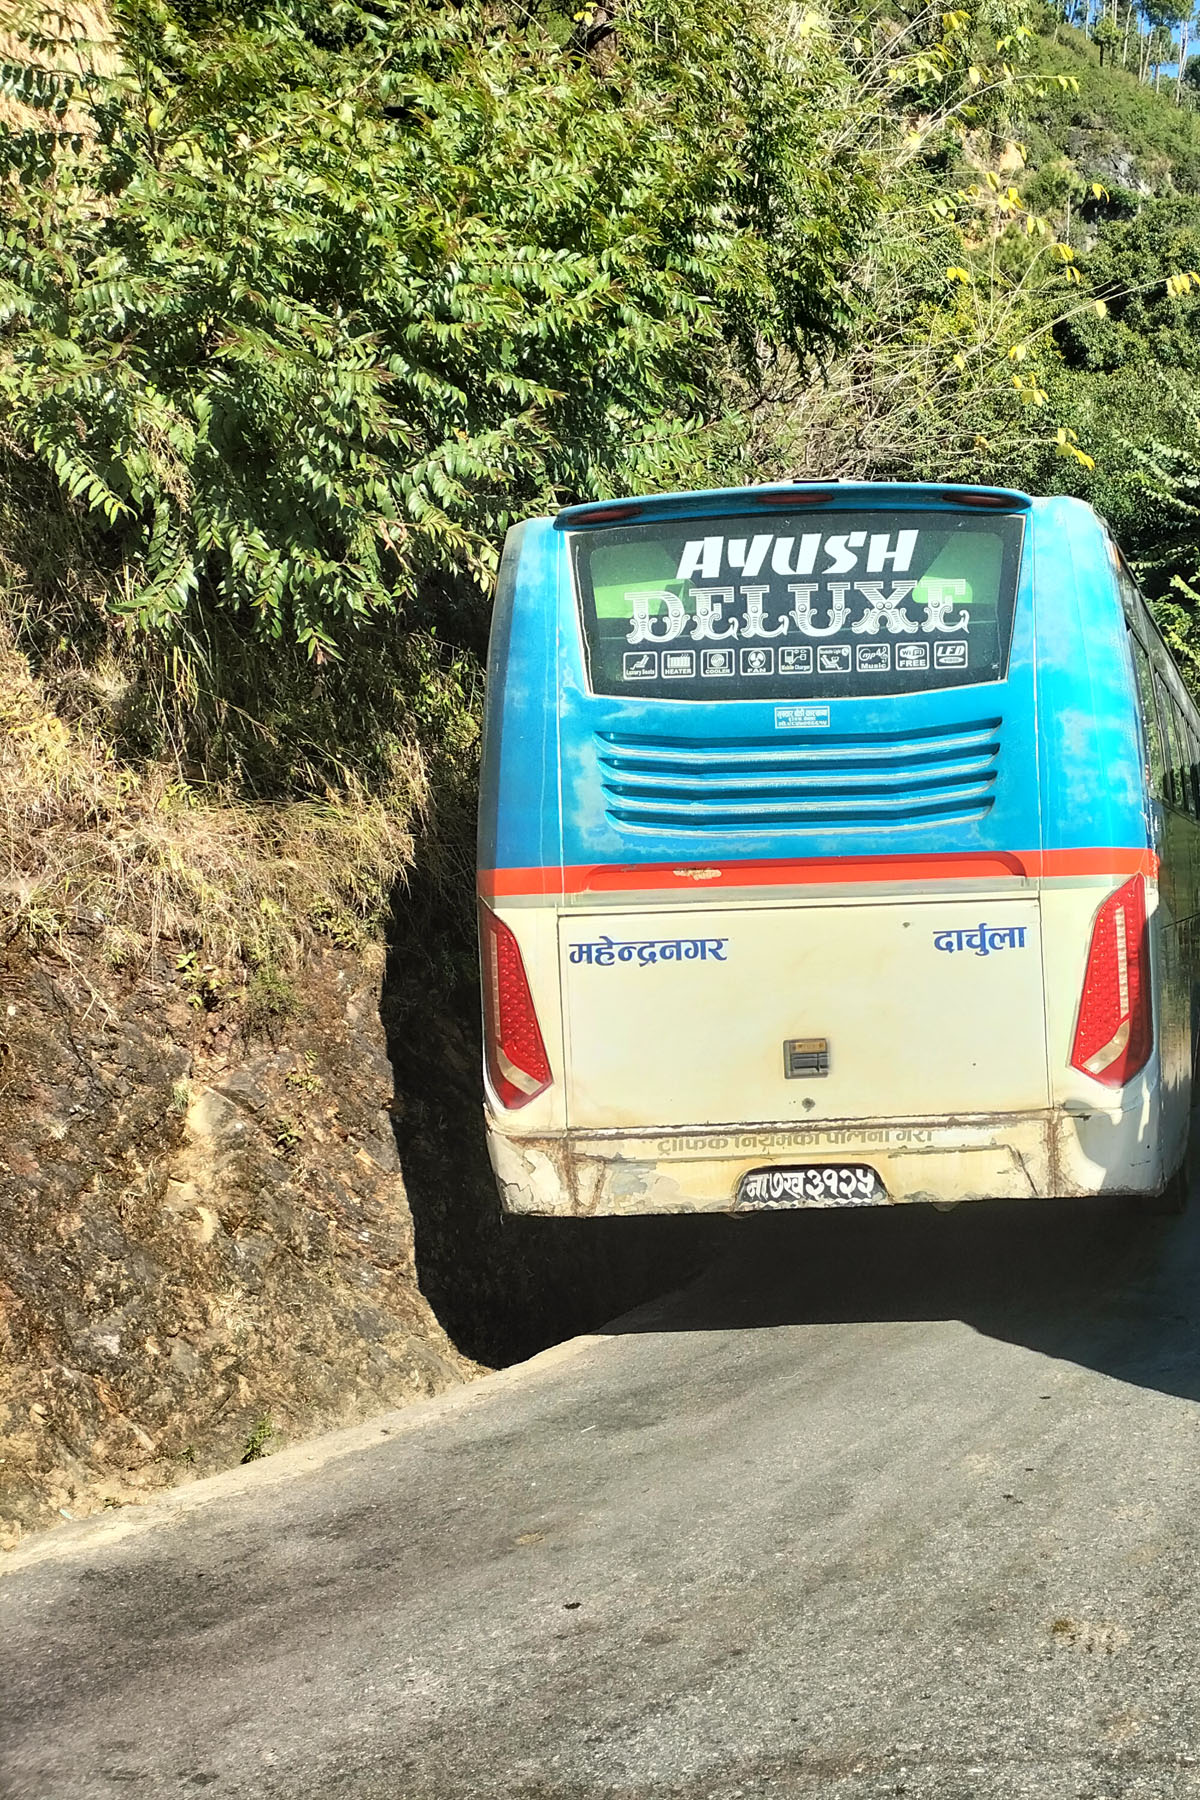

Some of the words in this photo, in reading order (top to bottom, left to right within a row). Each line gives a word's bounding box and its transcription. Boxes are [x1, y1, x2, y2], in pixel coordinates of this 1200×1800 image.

[676, 529, 919, 579] AYUSH
[623, 578, 969, 645] DELUXE
[899, 659, 926, 667] FREE
[936, 645, 965, 657] LED
[568, 935, 729, 967] महेन्द्रनगर
[932, 922, 1027, 956] दार्चुला
